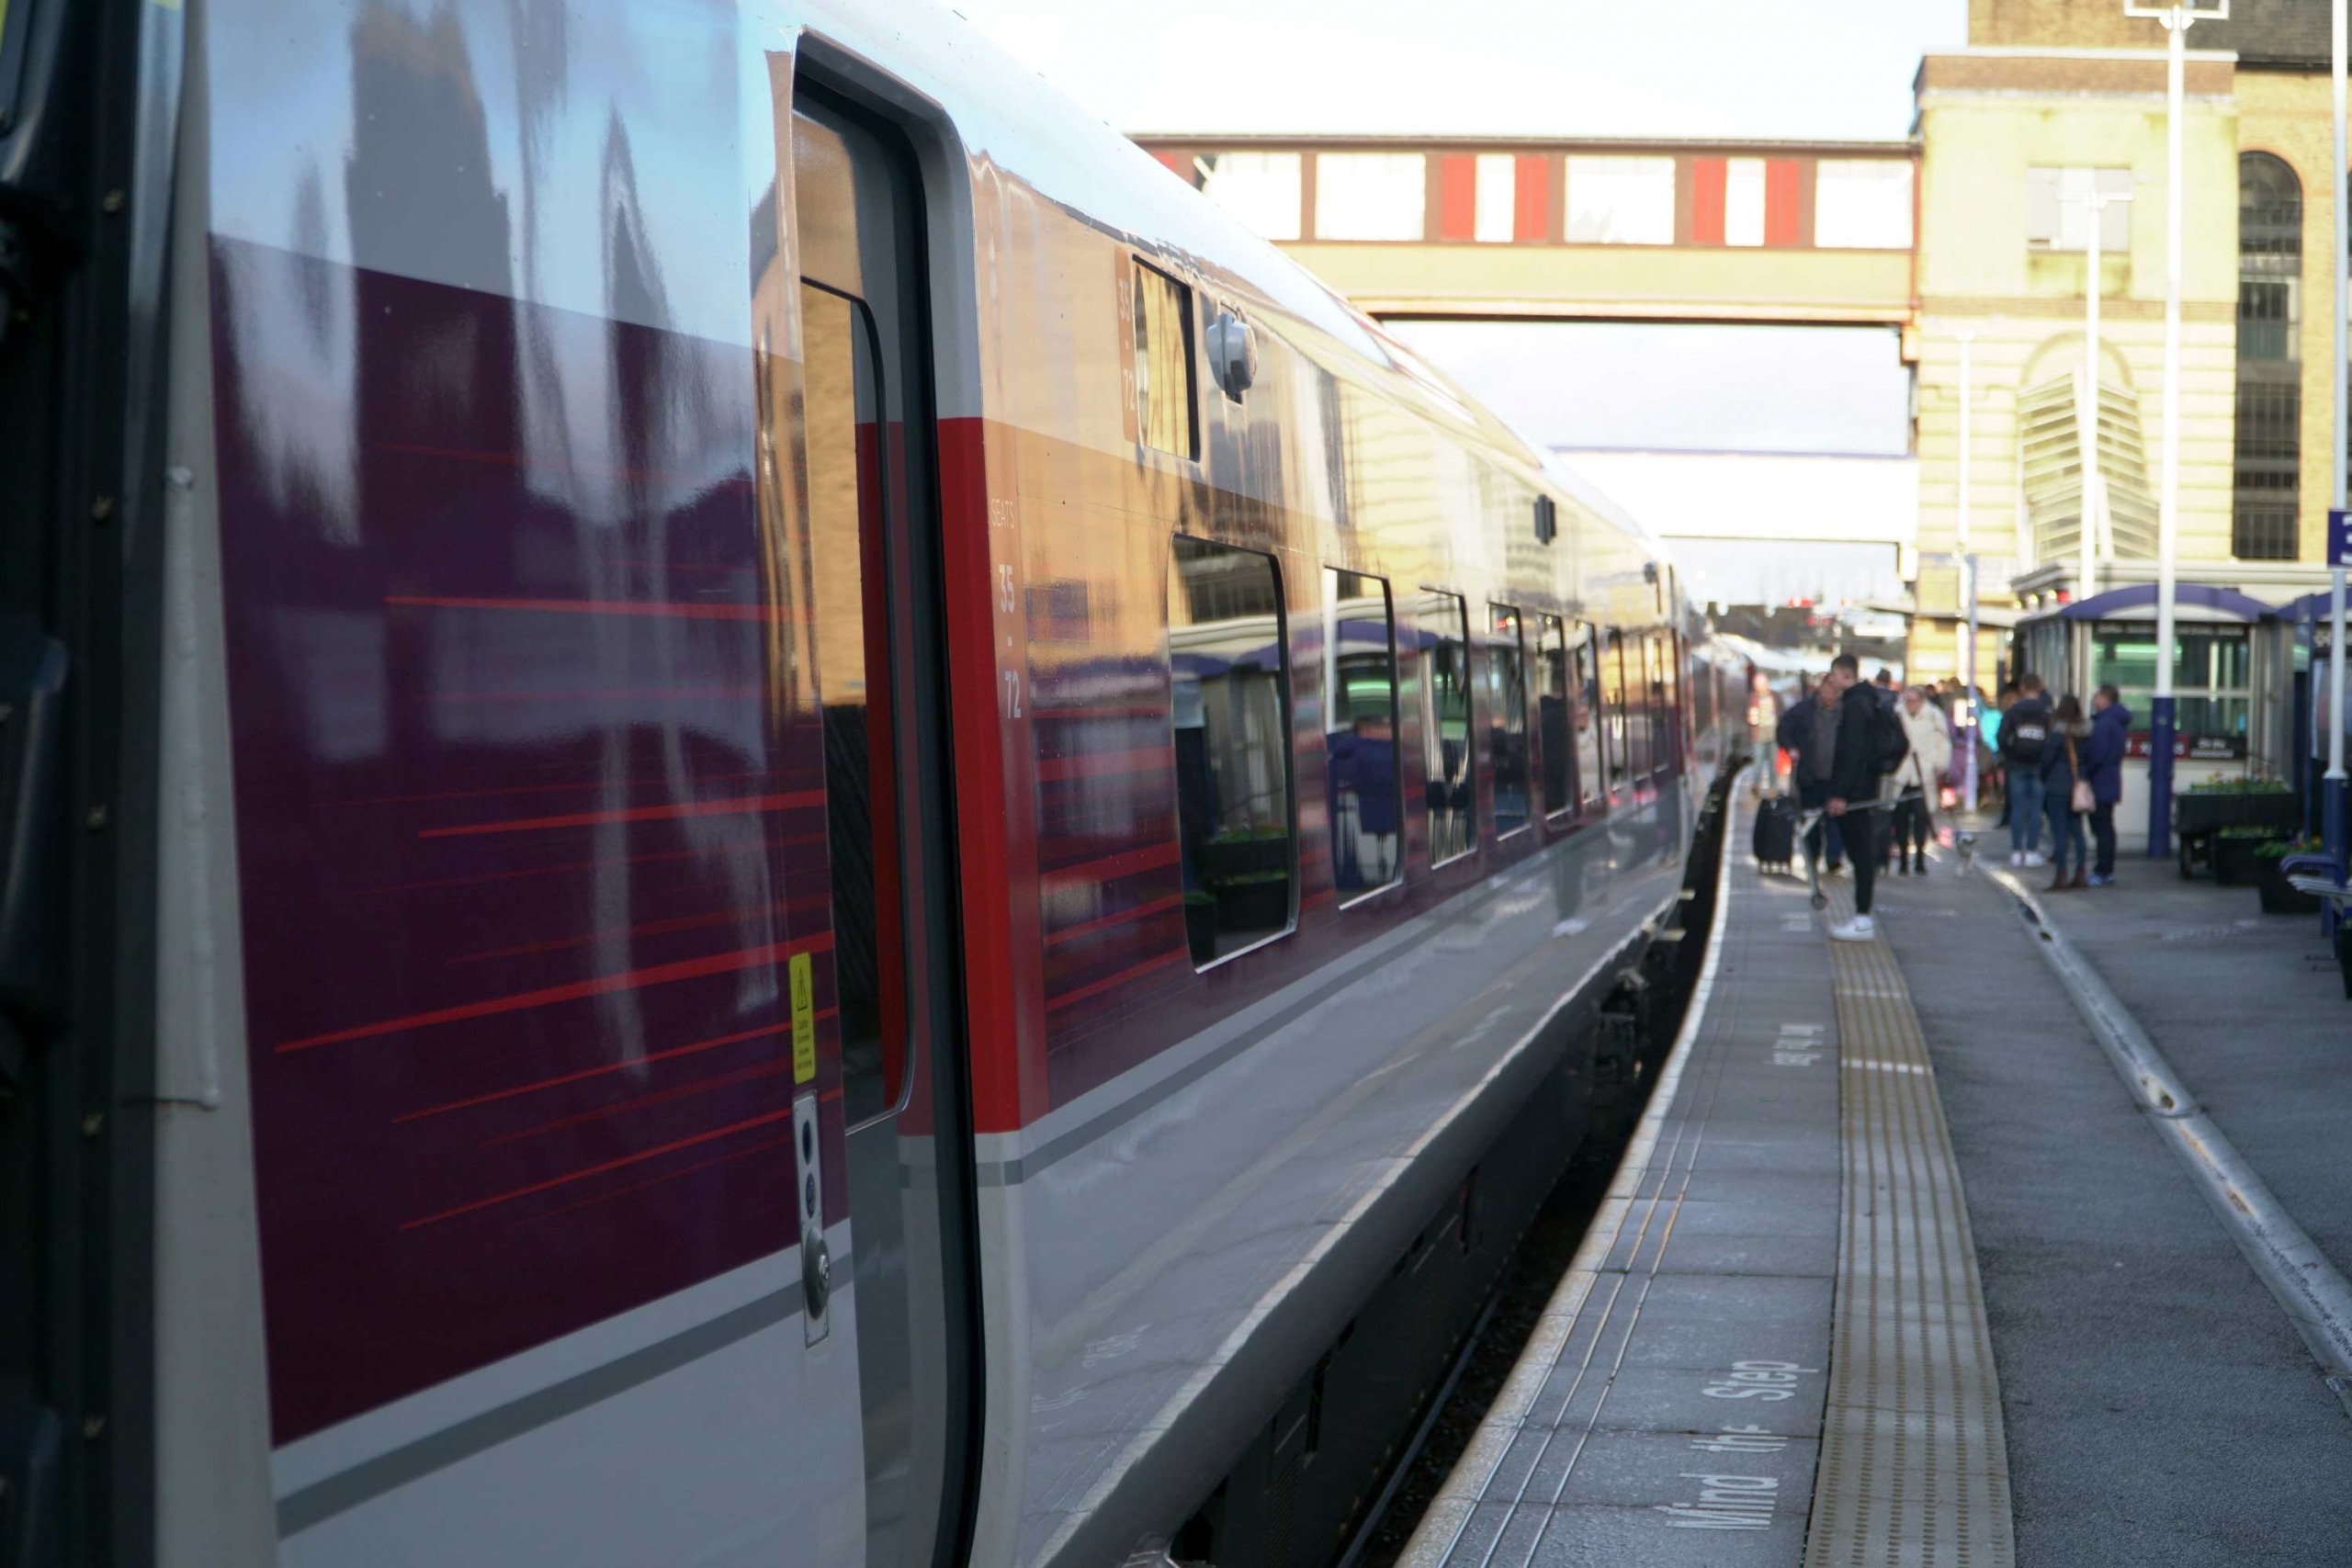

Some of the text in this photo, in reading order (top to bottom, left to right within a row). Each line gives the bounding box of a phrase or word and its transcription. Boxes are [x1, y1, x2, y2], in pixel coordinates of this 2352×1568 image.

[1118, 278, 1131, 321] 35
[1123, 369, 1136, 412] 72
[990, 499, 1015, 530] SEATS
[998, 563, 1015, 614] 35
[1003, 671, 1022, 719] 72
[1702, 1359, 1819, 1402] Step
[1664, 1472, 1780, 1531] Mind
